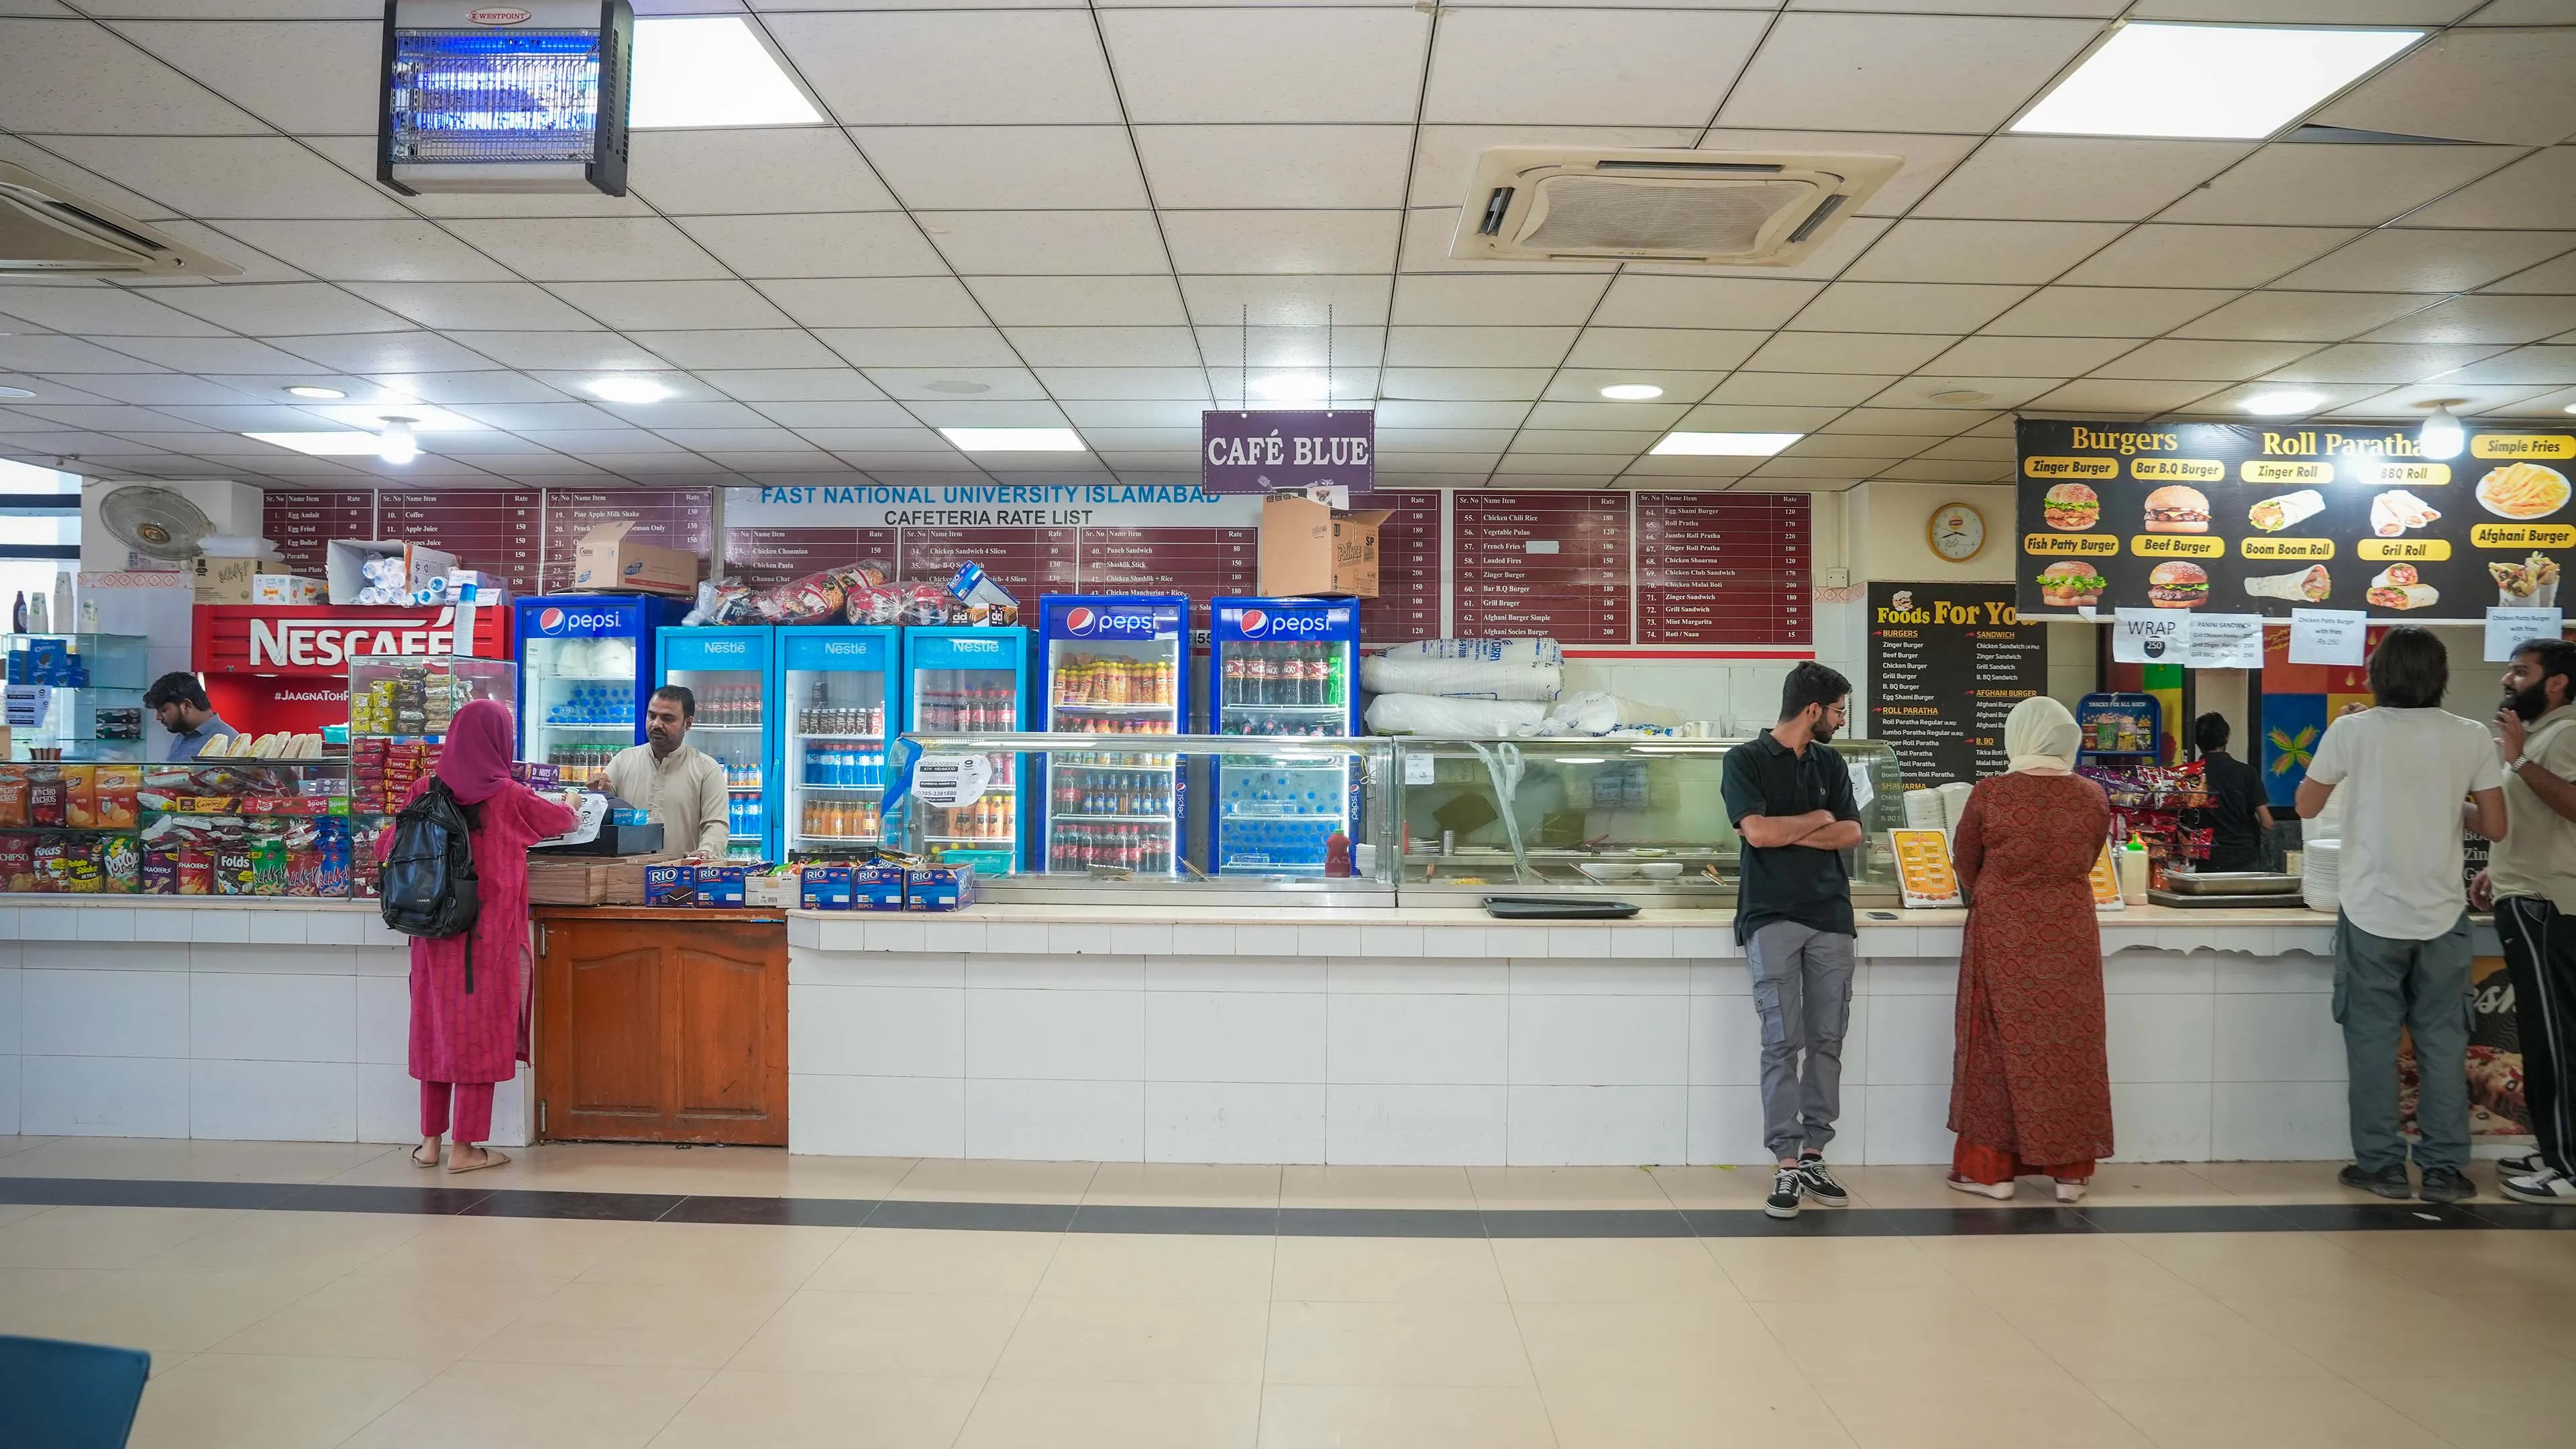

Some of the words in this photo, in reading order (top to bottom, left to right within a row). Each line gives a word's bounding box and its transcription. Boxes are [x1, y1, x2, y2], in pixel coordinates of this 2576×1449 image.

[1208, 429, 1284, 466] CAFÉ
[1293, 437, 1369, 466] BLUE
[2072, 427, 2178, 455] Burgers
[2263, 433, 2316, 455] Roll
[2487, 440, 2528, 454] Simple
[2531, 440, 2561, 453] Fries
[2033, 461, 2070, 474] Zinger
[2072, 462, 2110, 474] Burger
[2136, 462, 2156, 474] Bar
[2159, 463, 2178, 475] B.Q
[2182, 464, 2218, 476] Burger
[2257, 466, 2293, 478] Zinger
[2297, 466, 2317, 478] Roll
[2381, 468, 2402, 479] BBQ
[2407, 468, 2427, 480] Roll
[761, 486, 820, 504] FAST
[824, 486, 941, 504] NATIONAL
[944, 486, 1079, 504] UNIVERSITY
[588, 511, 606, 519] Apple
[884, 510, 993, 525] CAFETERIA
[997, 510, 1047, 525] RATE
[1052, 510, 1093, 525] LIST
[1366, 536, 1375, 546] SP
[2479, 529, 2525, 544] Afghani
[2528, 531, 2570, 543] Burger
[2027, 537, 2048, 549] Fish
[2051, 539, 2079, 551] Patty
[2081, 539, 2116, 551] Burger
[2145, 539, 2171, 551] Beef
[2174, 541, 2210, 553] Burger
[2246, 543, 2274, 555] Boom
[2278, 542, 2306, 555] Boom
[2310, 544, 2330, 555] Roll
[2382, 545, 2402, 555] Gril
[2406, 545, 2426, 556] Roll
[1337, 543, 1362, 561] PRINCE
[949, 575, 960, 588] RIO
[1877, 607, 1930, 624] Foods
[1934, 601, 1980, 625] For
[1984, 602, 2040, 626] Yo
[568, 611, 619, 631] pepsi
[1099, 612, 1157, 633] pepsi
[1273, 614, 1330, 635] pepsi
[2129, 621, 2176, 635] WRAP
[250, 606, 454, 666] NESCAFÉ
[1483, 628, 1507, 636] Afghani
[2146, 642, 2161, 650] 250
[307, 800, 327, 808] Spout
[0, 853, 29, 861] CHIPSO
[221, 855, 250, 868] Folds
[650, 869, 676, 883] RIO
[700, 870, 719, 880] RIO
[806, 870, 826, 880] RIO
[858, 870, 878, 881] RIO
[911, 871, 931, 881] RIO
[959, 875, 967, 894] RIO
